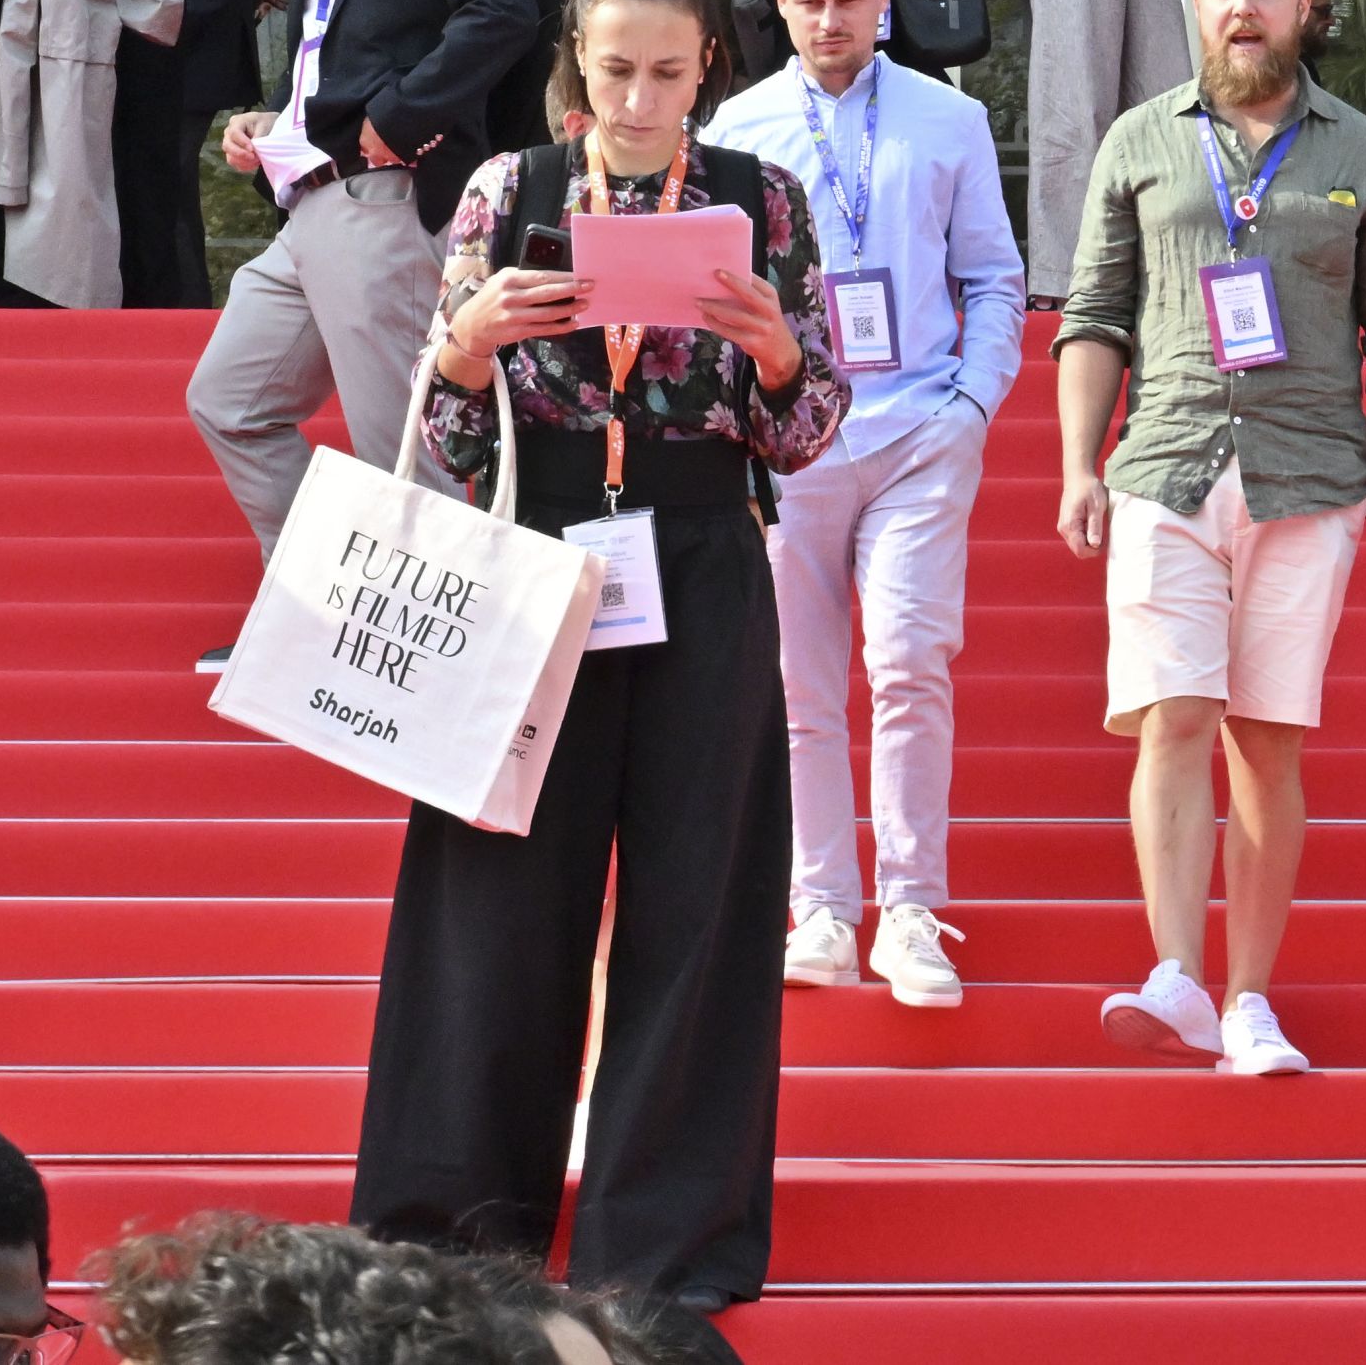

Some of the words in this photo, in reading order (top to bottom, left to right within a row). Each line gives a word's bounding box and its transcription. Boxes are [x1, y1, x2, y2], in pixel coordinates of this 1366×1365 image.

[339, 529, 489, 625] FUTURE
[326, 582, 345, 610] IS
[350, 583, 467, 659] FILMED
[331, 627, 428, 695] HERE
[308, 686, 400, 746] Sharjah
